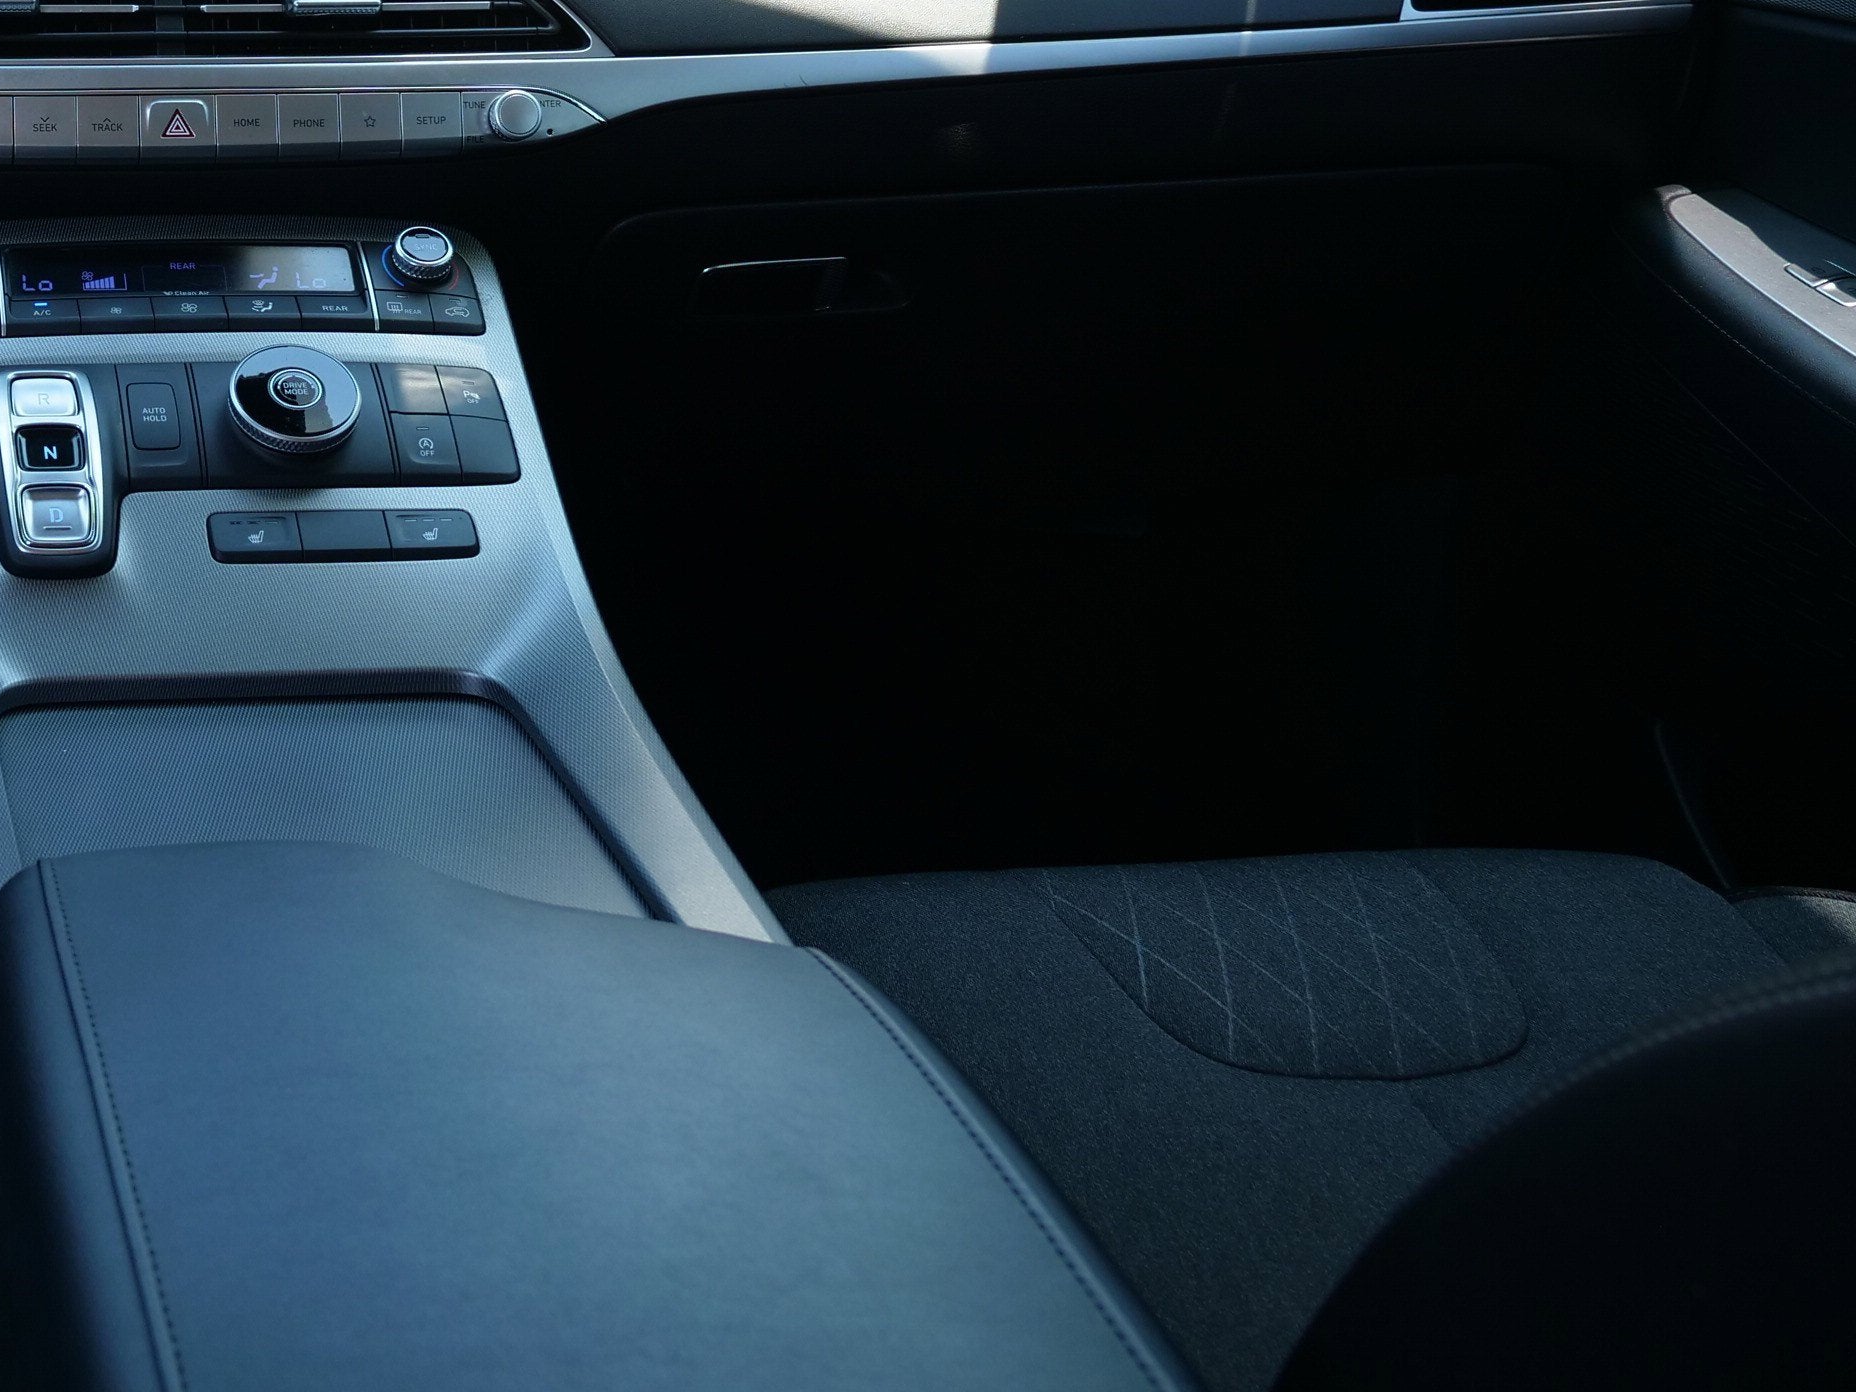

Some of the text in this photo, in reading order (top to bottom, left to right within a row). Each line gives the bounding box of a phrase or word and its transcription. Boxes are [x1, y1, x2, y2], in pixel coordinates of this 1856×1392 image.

[463, 101, 485, 109] TUNE
[539, 100, 561, 108] NTER
[233, 118, 260, 127] HOME
[293, 118, 325, 128] PHONE
[416, 116, 446, 125] SETUP
[33, 123, 58, 132] SEEK
[92, 122, 123, 132] TRACK
[466, 135, 485, 144] FILE
[169, 262, 196, 270] REAR
[38, 393, 49, 405] R
[43, 446, 57, 460] N
[49, 508, 64, 522] D
